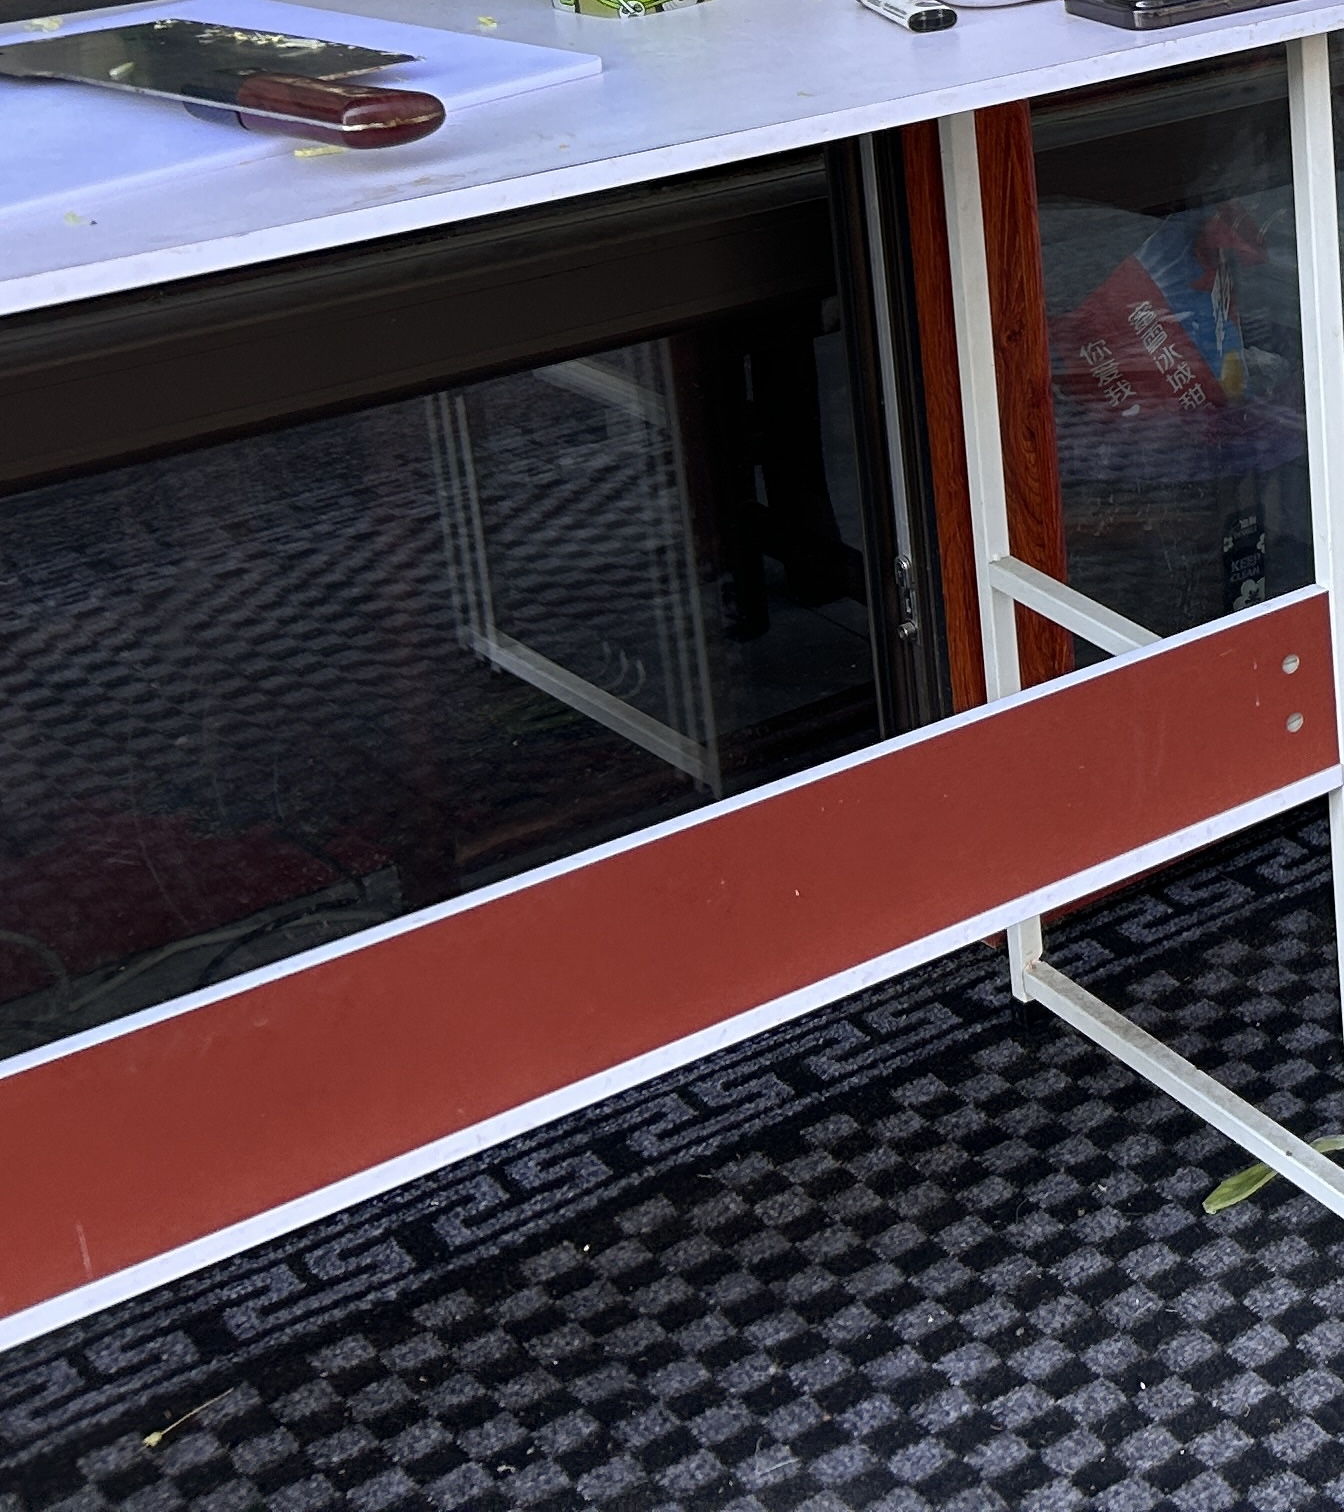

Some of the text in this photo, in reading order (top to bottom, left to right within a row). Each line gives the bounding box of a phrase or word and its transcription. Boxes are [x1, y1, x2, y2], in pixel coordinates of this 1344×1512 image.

[1079, 338, 1138, 408] 你爱我
[1231, 552, 1261, 573] KEEP
[1230, 565, 1261, 582] CLEAN
